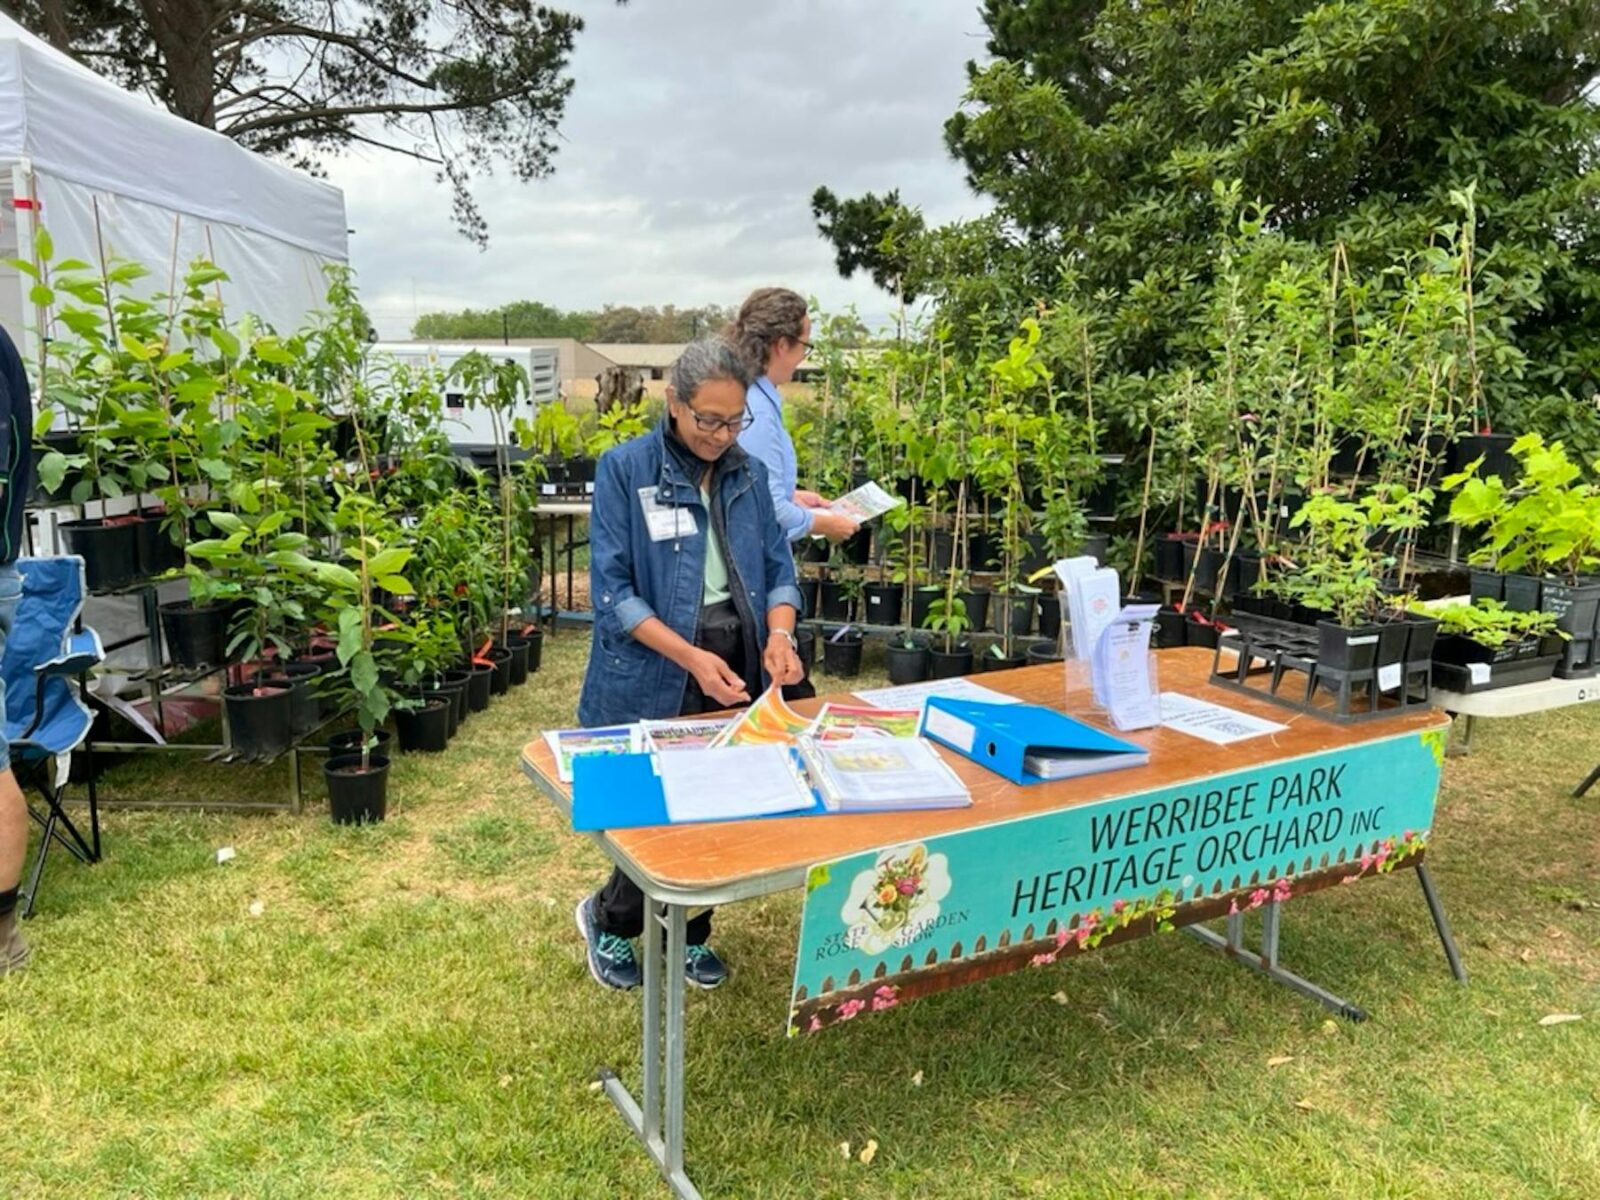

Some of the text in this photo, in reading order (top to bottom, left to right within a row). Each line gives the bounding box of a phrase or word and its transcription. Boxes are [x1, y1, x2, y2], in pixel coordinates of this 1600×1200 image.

[1091, 763, 1347, 853] WERRIBEE PARK
[1012, 806, 1385, 917] HERITAGE ORCHARD INC
[815, 931, 935, 961] ROSE SHOW
[824, 911, 969, 946] STATE GARDEN
